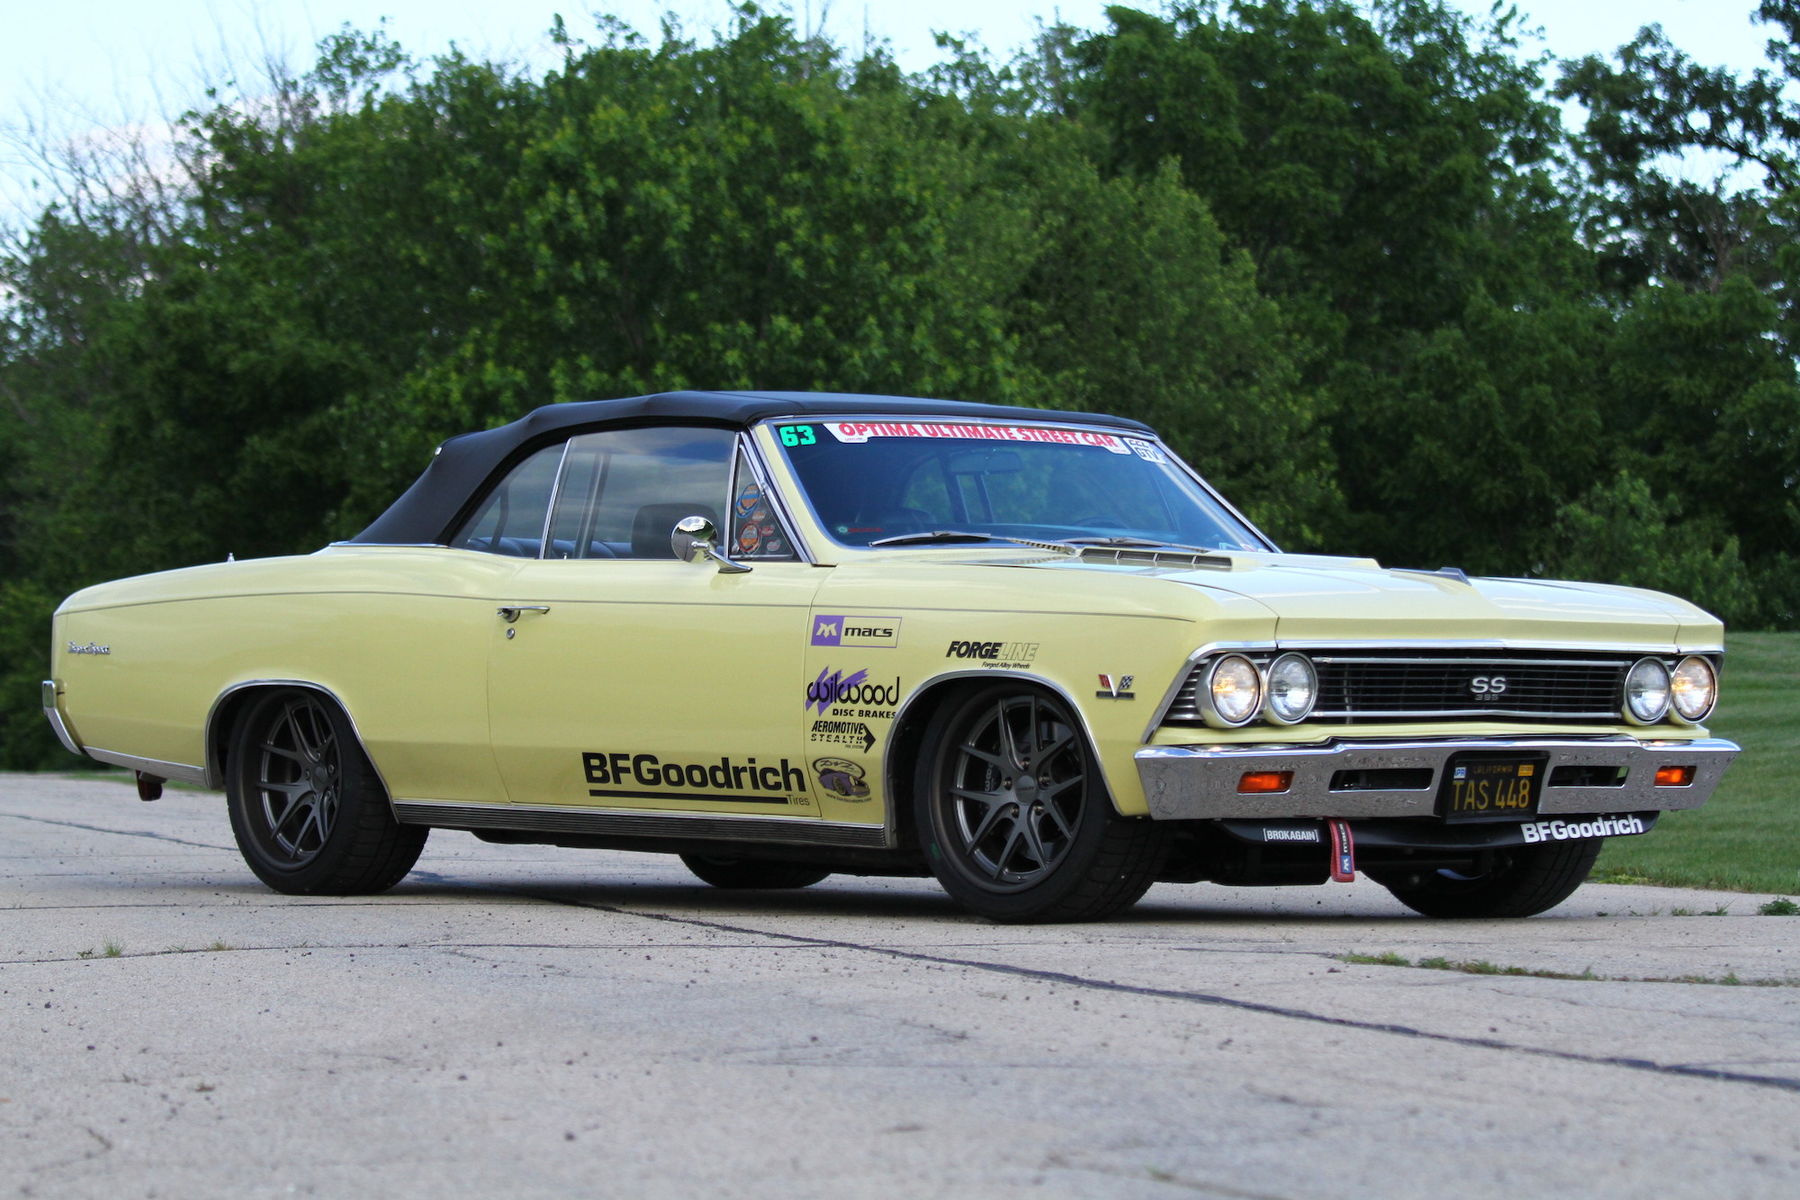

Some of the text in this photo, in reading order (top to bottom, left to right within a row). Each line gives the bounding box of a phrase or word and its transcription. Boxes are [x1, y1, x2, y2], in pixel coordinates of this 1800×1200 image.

[780, 425, 816, 447] 63
[838, 423, 1119, 448] OPTIMA ULTIMATE STREET CAR
[844, 627, 893, 638] macs
[945, 641, 1040, 661] FORGELINE
[982, 661, 1000, 669] Forged
[1471, 677, 1506, 693] SS
[832, 708, 897, 719] DISC BRAKES
[811, 720, 865, 735] AEROMOTIVE
[810, 733, 864, 744] STEALTH
[582, 752, 806, 792] BFGoodrich
[787, 795, 811, 806] Tires
[1453, 778, 1531, 810] TAS 448
[1520, 814, 1643, 843] BFGoodrich
